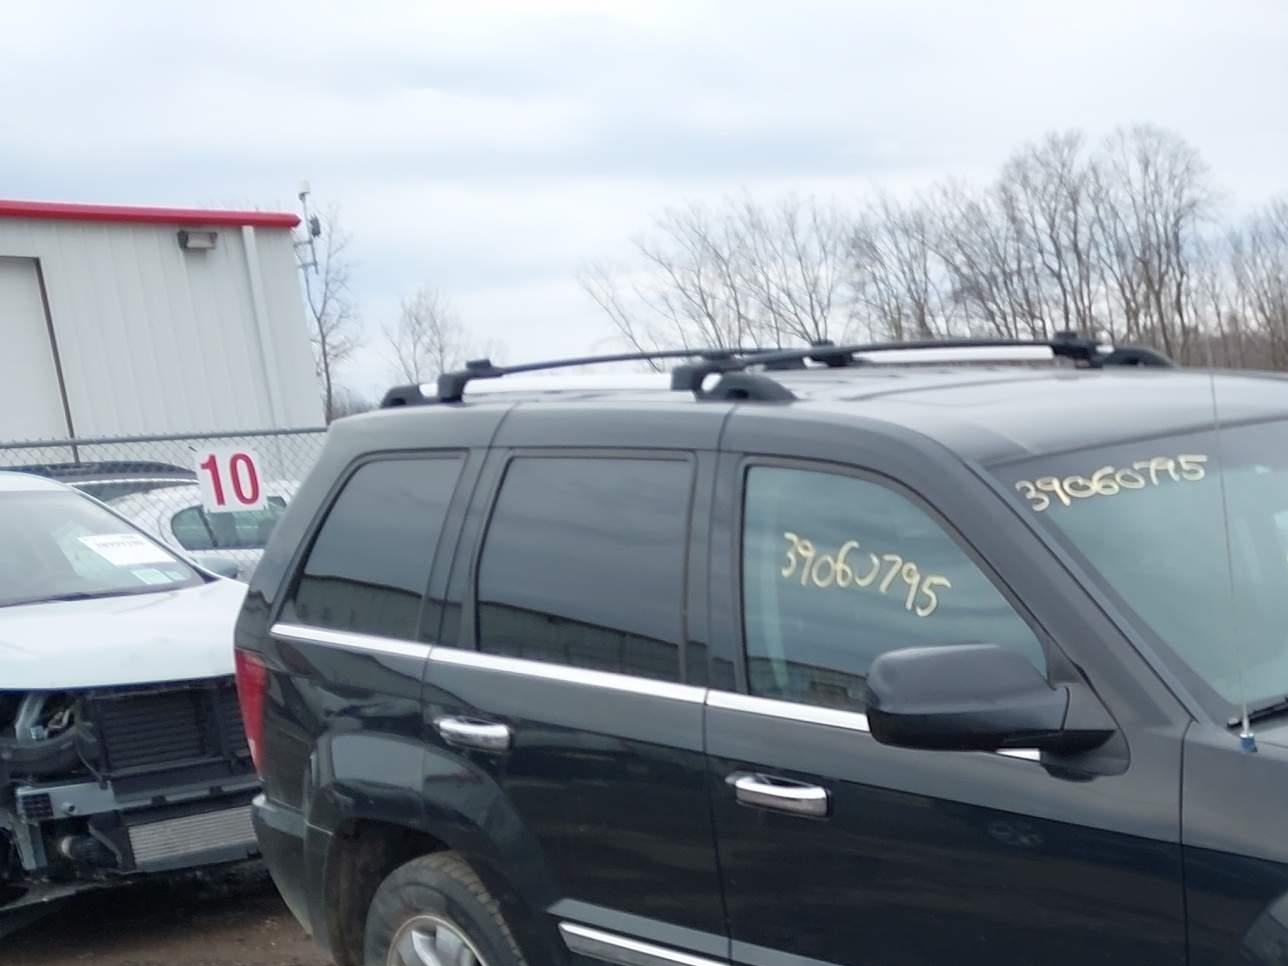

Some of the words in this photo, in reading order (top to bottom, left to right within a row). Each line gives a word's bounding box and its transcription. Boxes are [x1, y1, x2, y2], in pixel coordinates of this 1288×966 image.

[201, 453, 260, 506] 10
[1014, 453, 1209, 513] 39060795
[781, 531, 953, 618] 39060795
